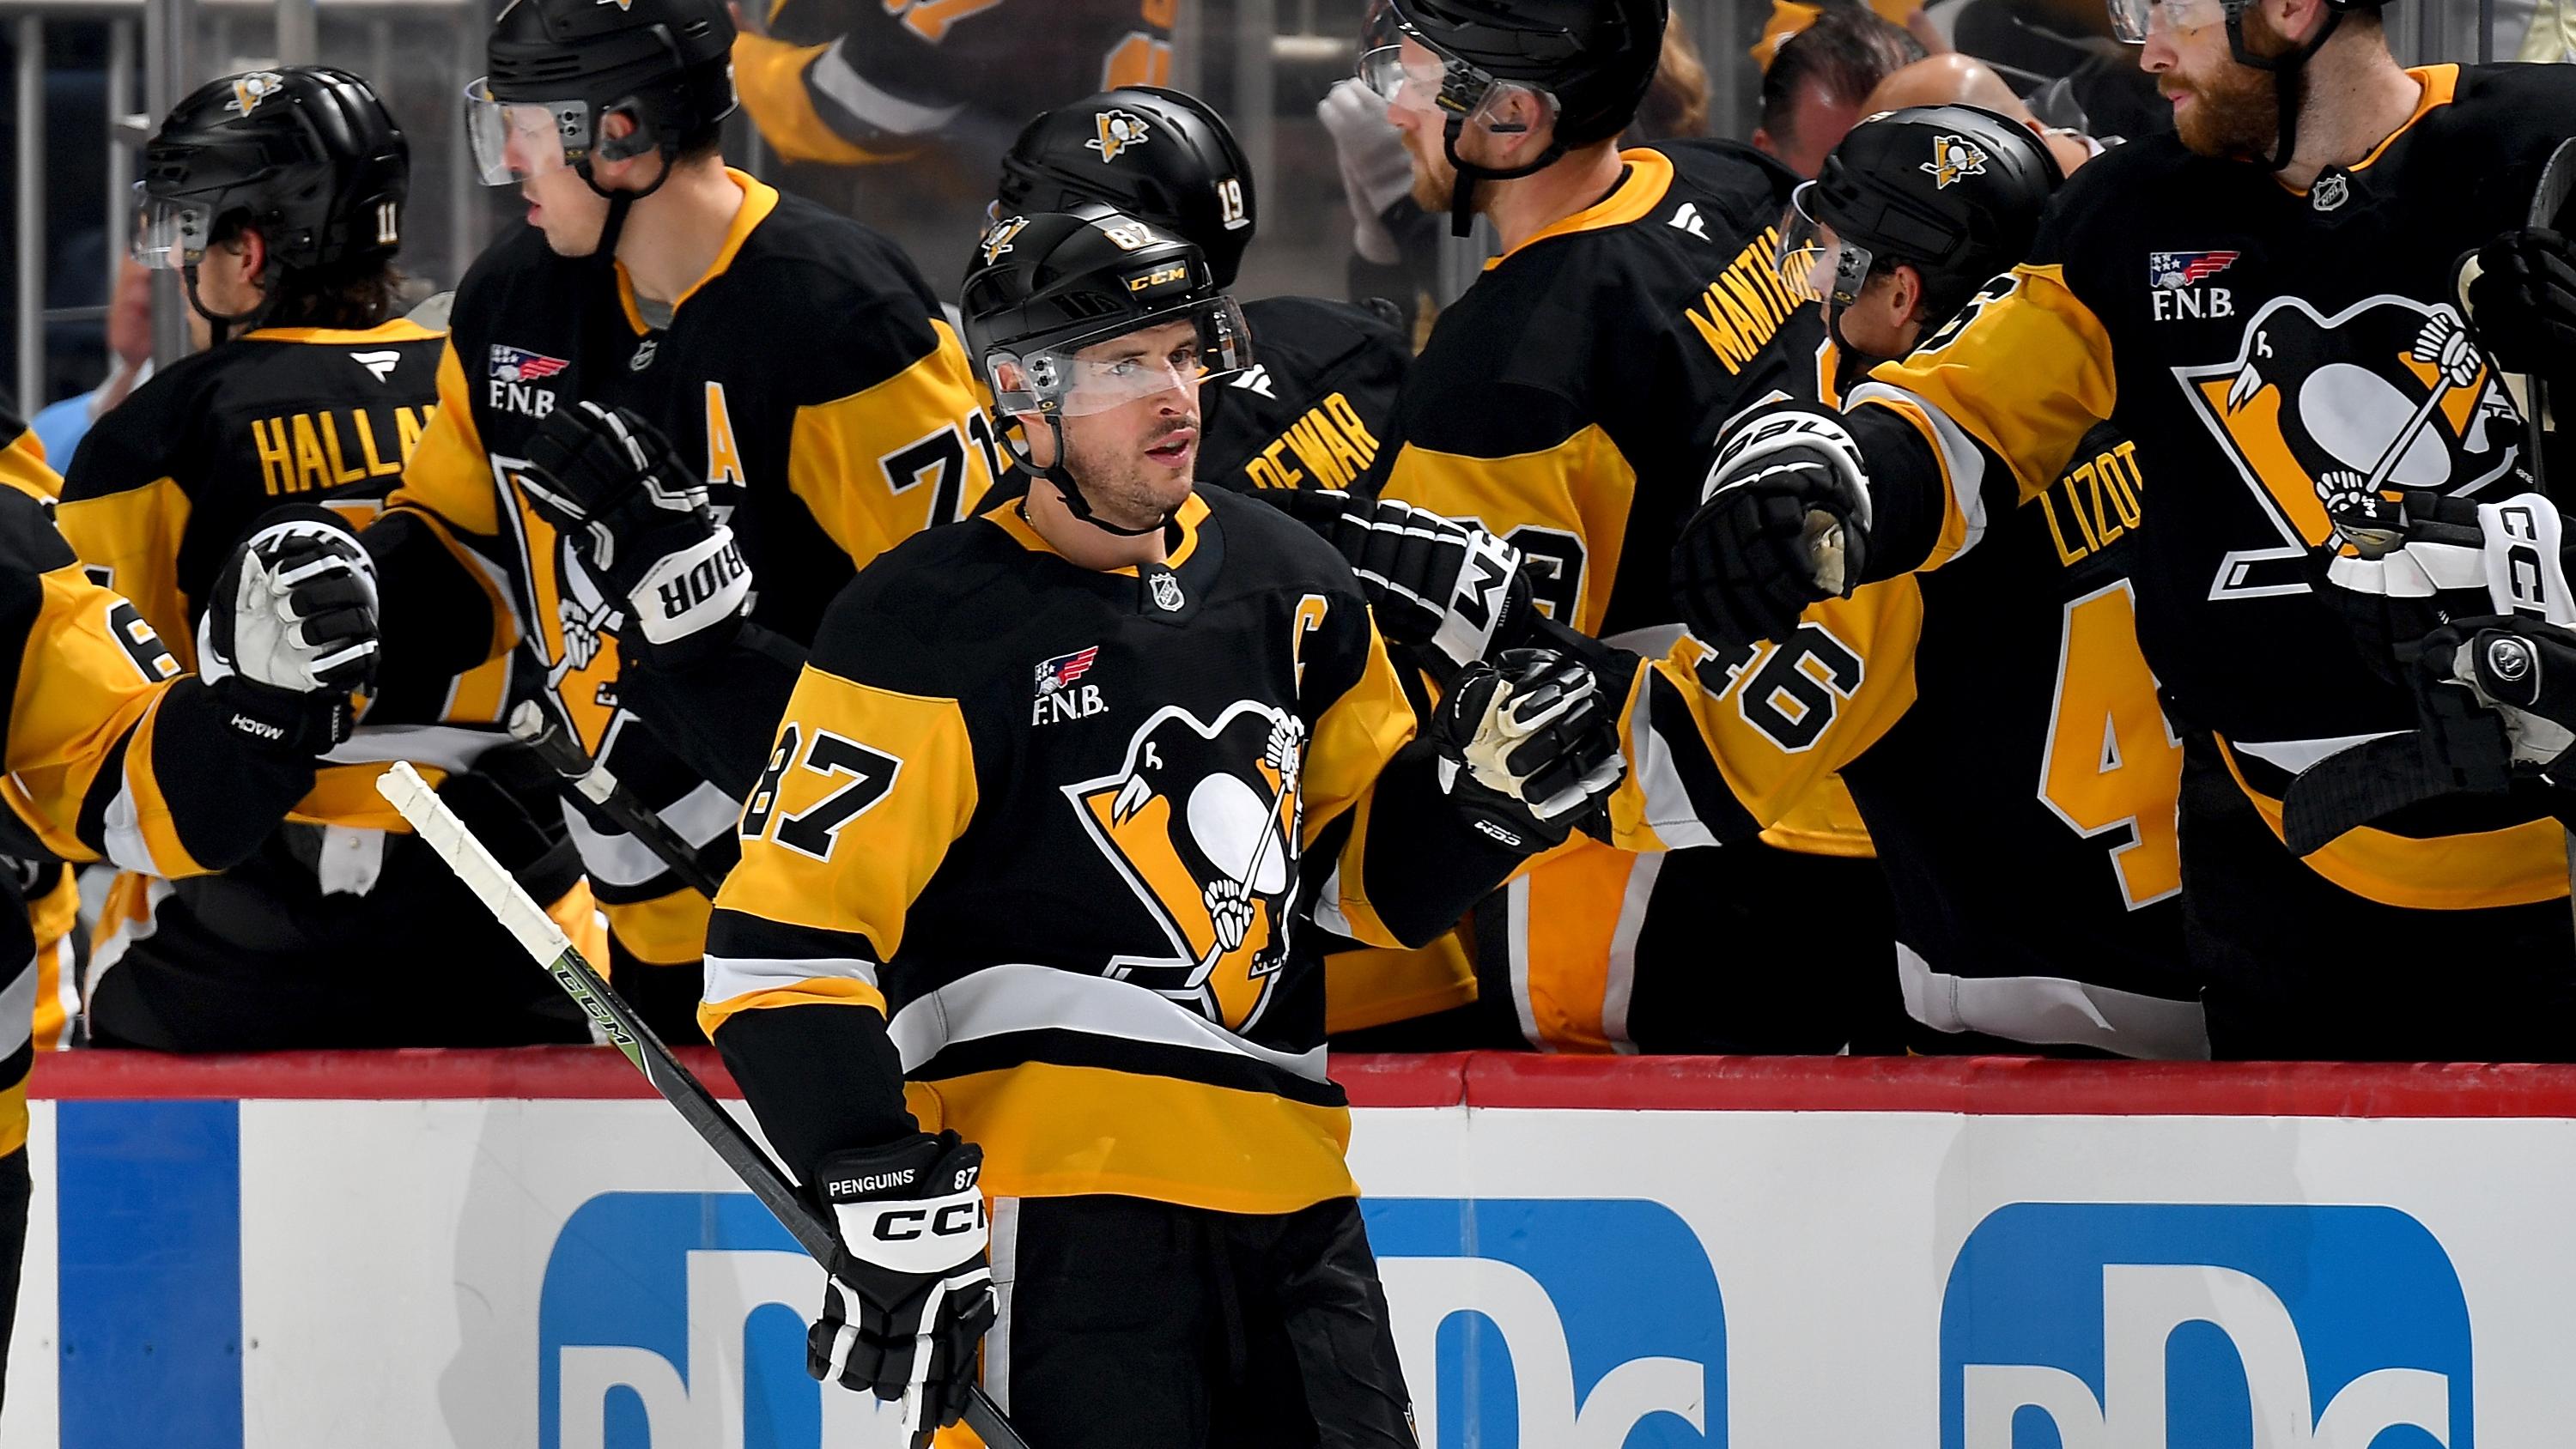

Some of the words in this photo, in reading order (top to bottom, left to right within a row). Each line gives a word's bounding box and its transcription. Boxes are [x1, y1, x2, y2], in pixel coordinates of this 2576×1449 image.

[1218, 178, 1244, 223] 19
[376, 202, 398, 244] 11
[1103, 221, 1157, 251] 87
[1129, 267, 1186, 291] CCM
[2151, 288, 2235, 321] F.N.B.
[489, 379, 556, 420] F.N.B
[251, 404, 436, 495] HALLA
[705, 380, 747, 488] A
[1245, 391, 1380, 490] DEWAR
[878, 405, 1004, 530] 71
[2039, 440, 2142, 567] LIZOT
[2500, 506, 2549, 621] CC
[1292, 594, 1328, 700] C
[231, 713, 284, 740] MACH
[1032, 684, 1109, 726] F.N.B.
[738, 721, 904, 864] 87
[1473, 820, 1522, 846] CCM
[555, 967, 636, 1045] CCM
[829, 1168, 914, 1197] PENGUINS
[954, 1167, 978, 1190] 87
[872, 1199, 987, 1241] CC
